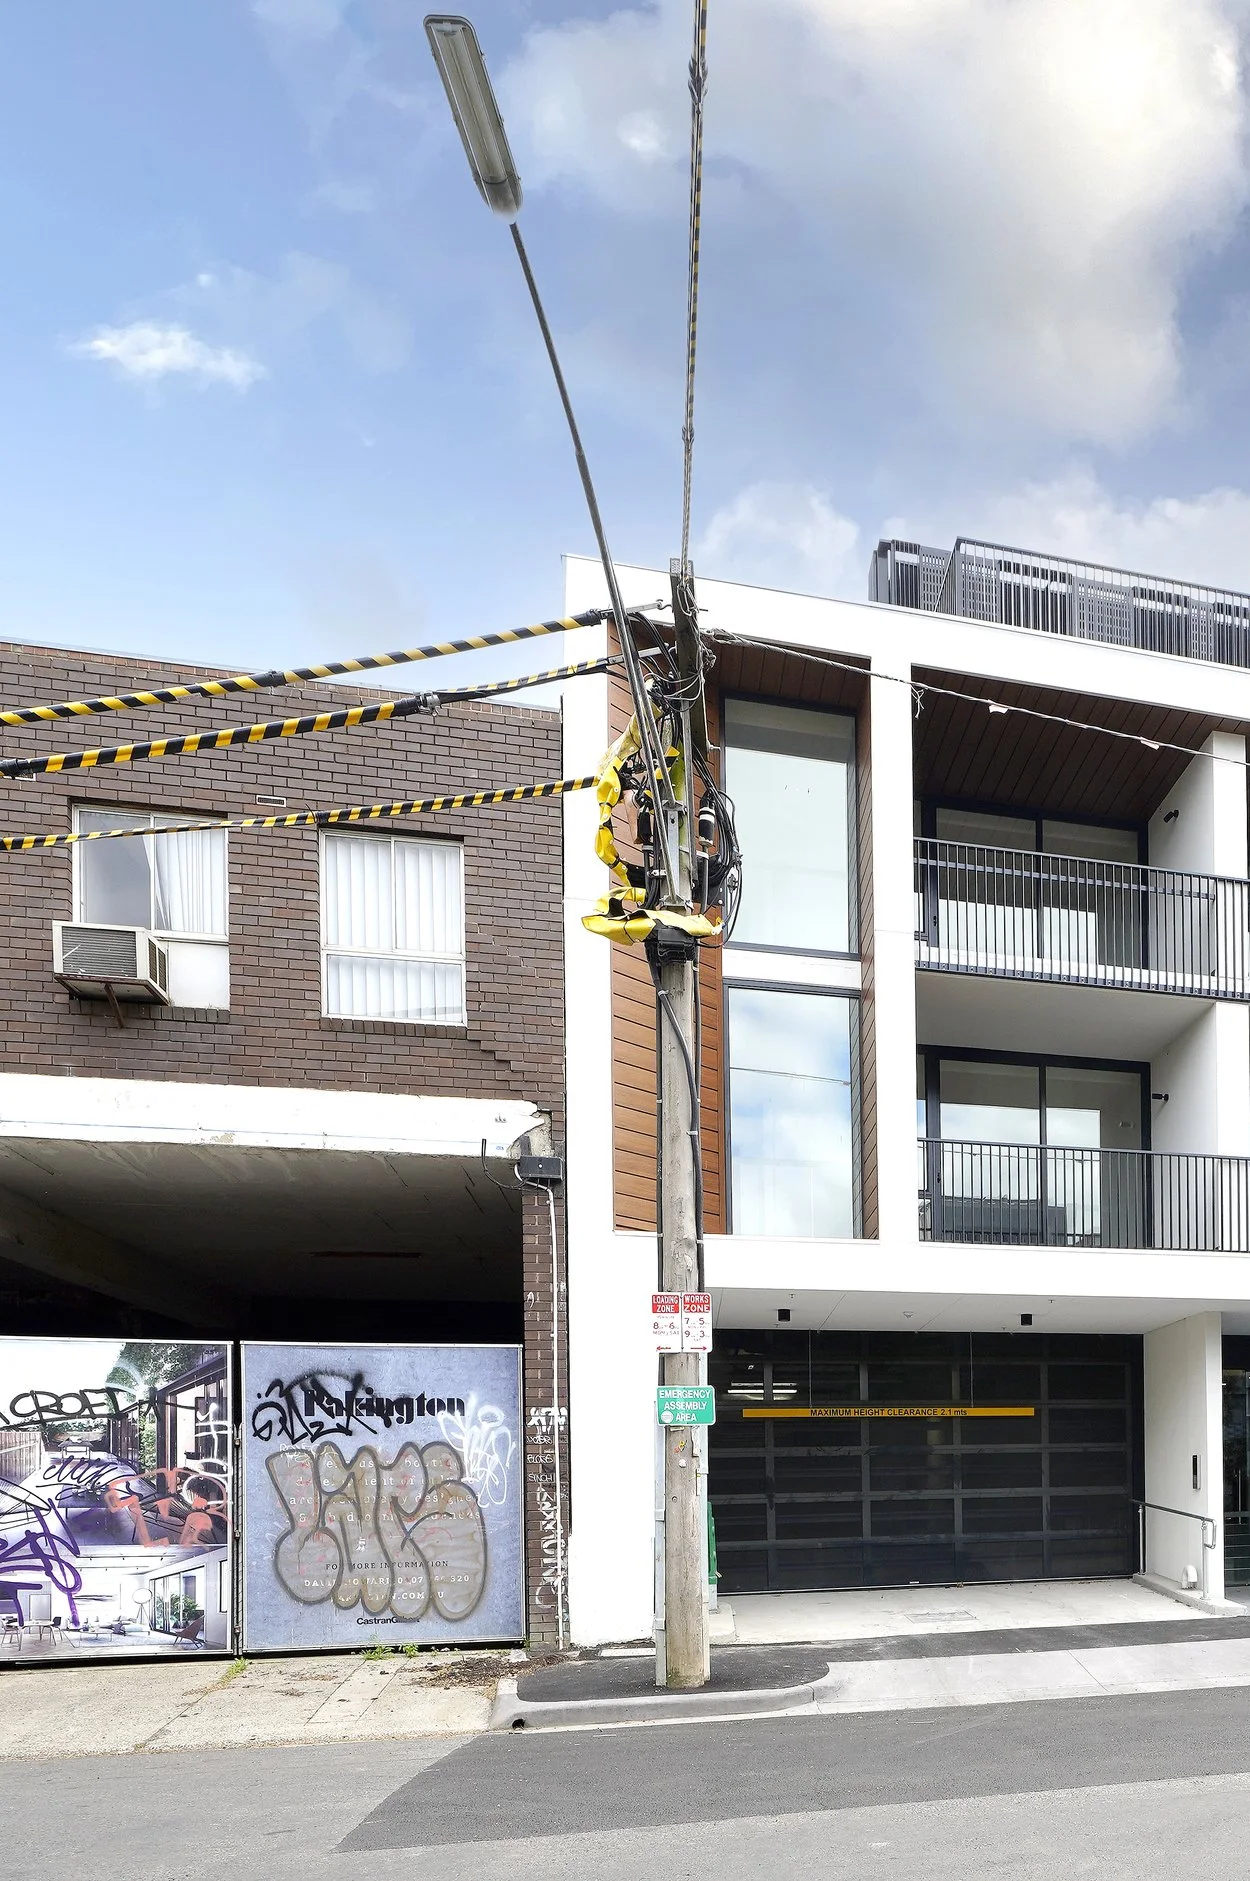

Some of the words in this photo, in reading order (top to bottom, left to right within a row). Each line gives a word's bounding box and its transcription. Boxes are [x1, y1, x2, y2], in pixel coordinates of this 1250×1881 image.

[652, 1295, 679, 1304] LOADING
[684, 1295, 710, 1304] WORKS
[656, 1304, 675, 1313] ZONE
[683, 1304, 710, 1312] ZONE
[659, 1389, 711, 1399] EMERGENCY
[664, 1401, 707, 1410] ASSEMBLY
[810, 1409, 851, 1417] MAXIMUM
[887, 1408, 938, 1416] CLEARANCE
[940, 1408, 952, 1416] 2.1
[953, 1408, 968, 1416] mts
[675, 1413, 698, 1422] AREA
